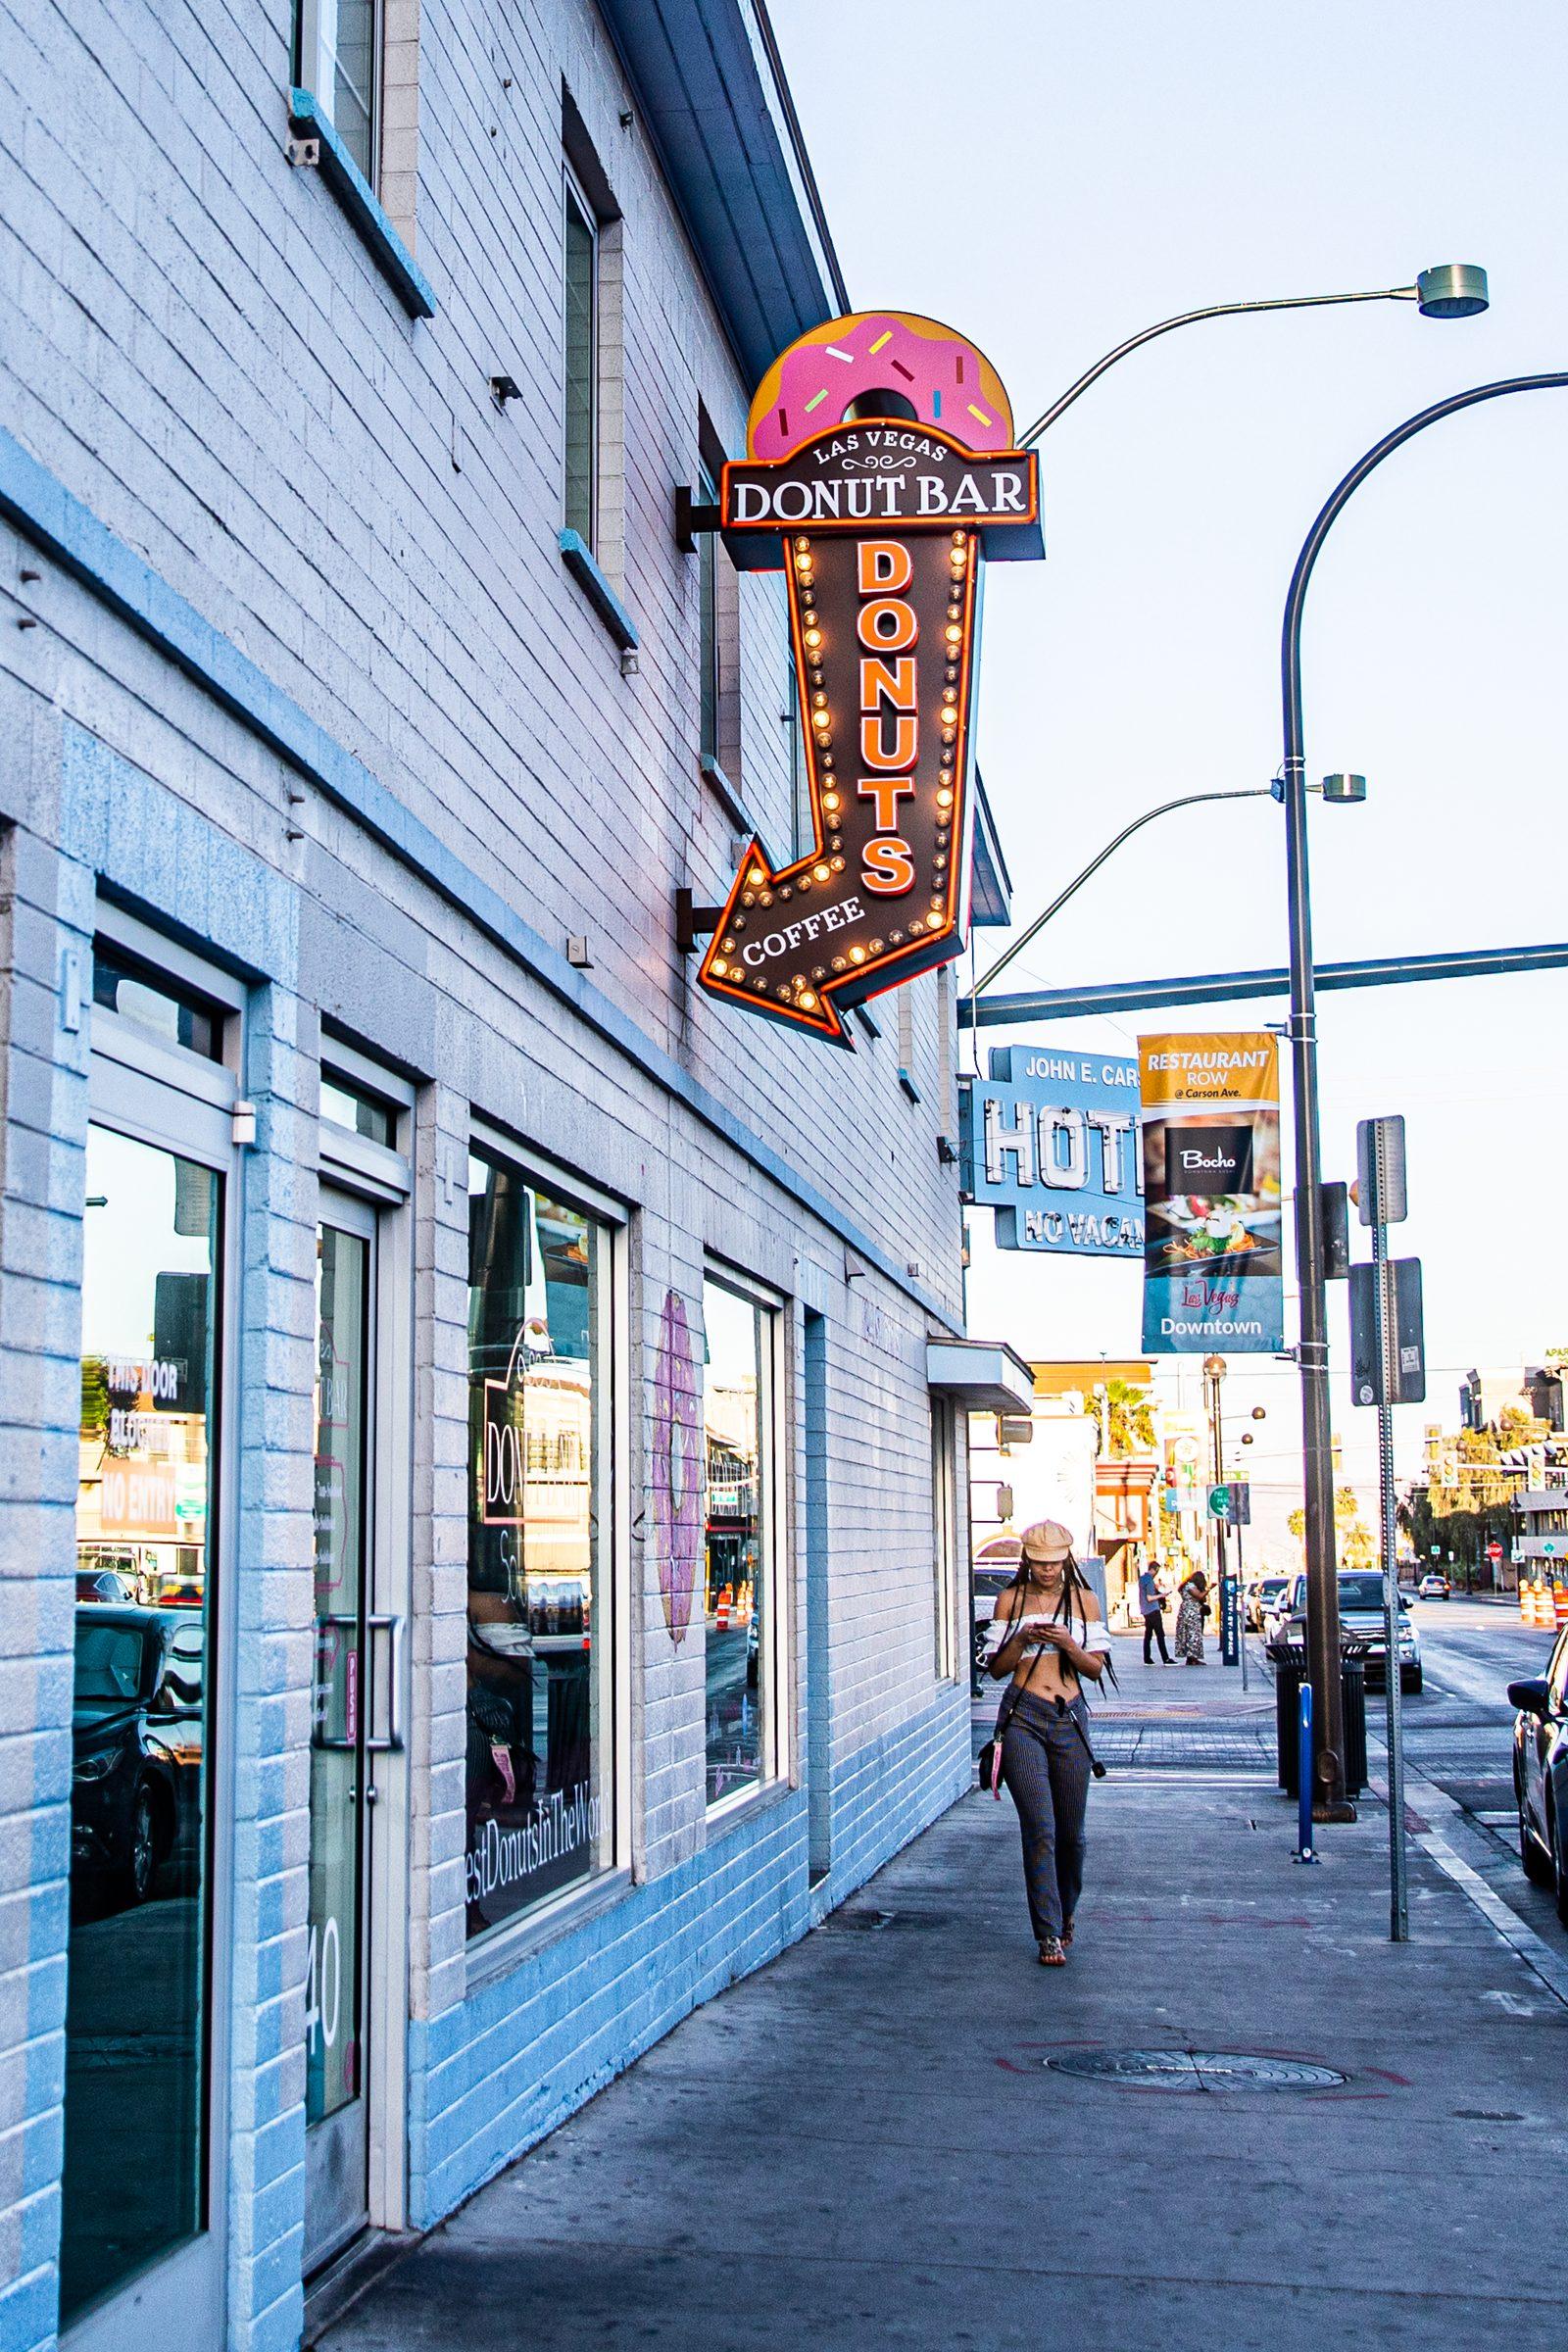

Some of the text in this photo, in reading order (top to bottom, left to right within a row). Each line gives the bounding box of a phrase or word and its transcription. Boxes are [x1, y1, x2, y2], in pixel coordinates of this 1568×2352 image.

[813, 431, 948, 465] LAS VEGAS
[734, 472, 1026, 521] DONUT BAR
[858, 540, 919, 894] DONUTS
[743, 896, 865, 965] COFFEE
[1026, 1056, 1140, 1088] JOHN E. CAR
[1148, 1051, 1269, 1070] RESTAURANT
[1175, 1088, 1242, 1099] @ Carson Ave.
[1187, 1071, 1229, 1086] ROW
[1179, 1146, 1236, 1169] Bocho
[1025, 1209, 1063, 1244] NO
[1182, 1279, 1240, 1315] Las Vegas
[1161, 1318, 1262, 1335] Downtown
[141, 1359, 177, 1399] DOOR
[102, 1472, 175, 1522] NO ENTRY
